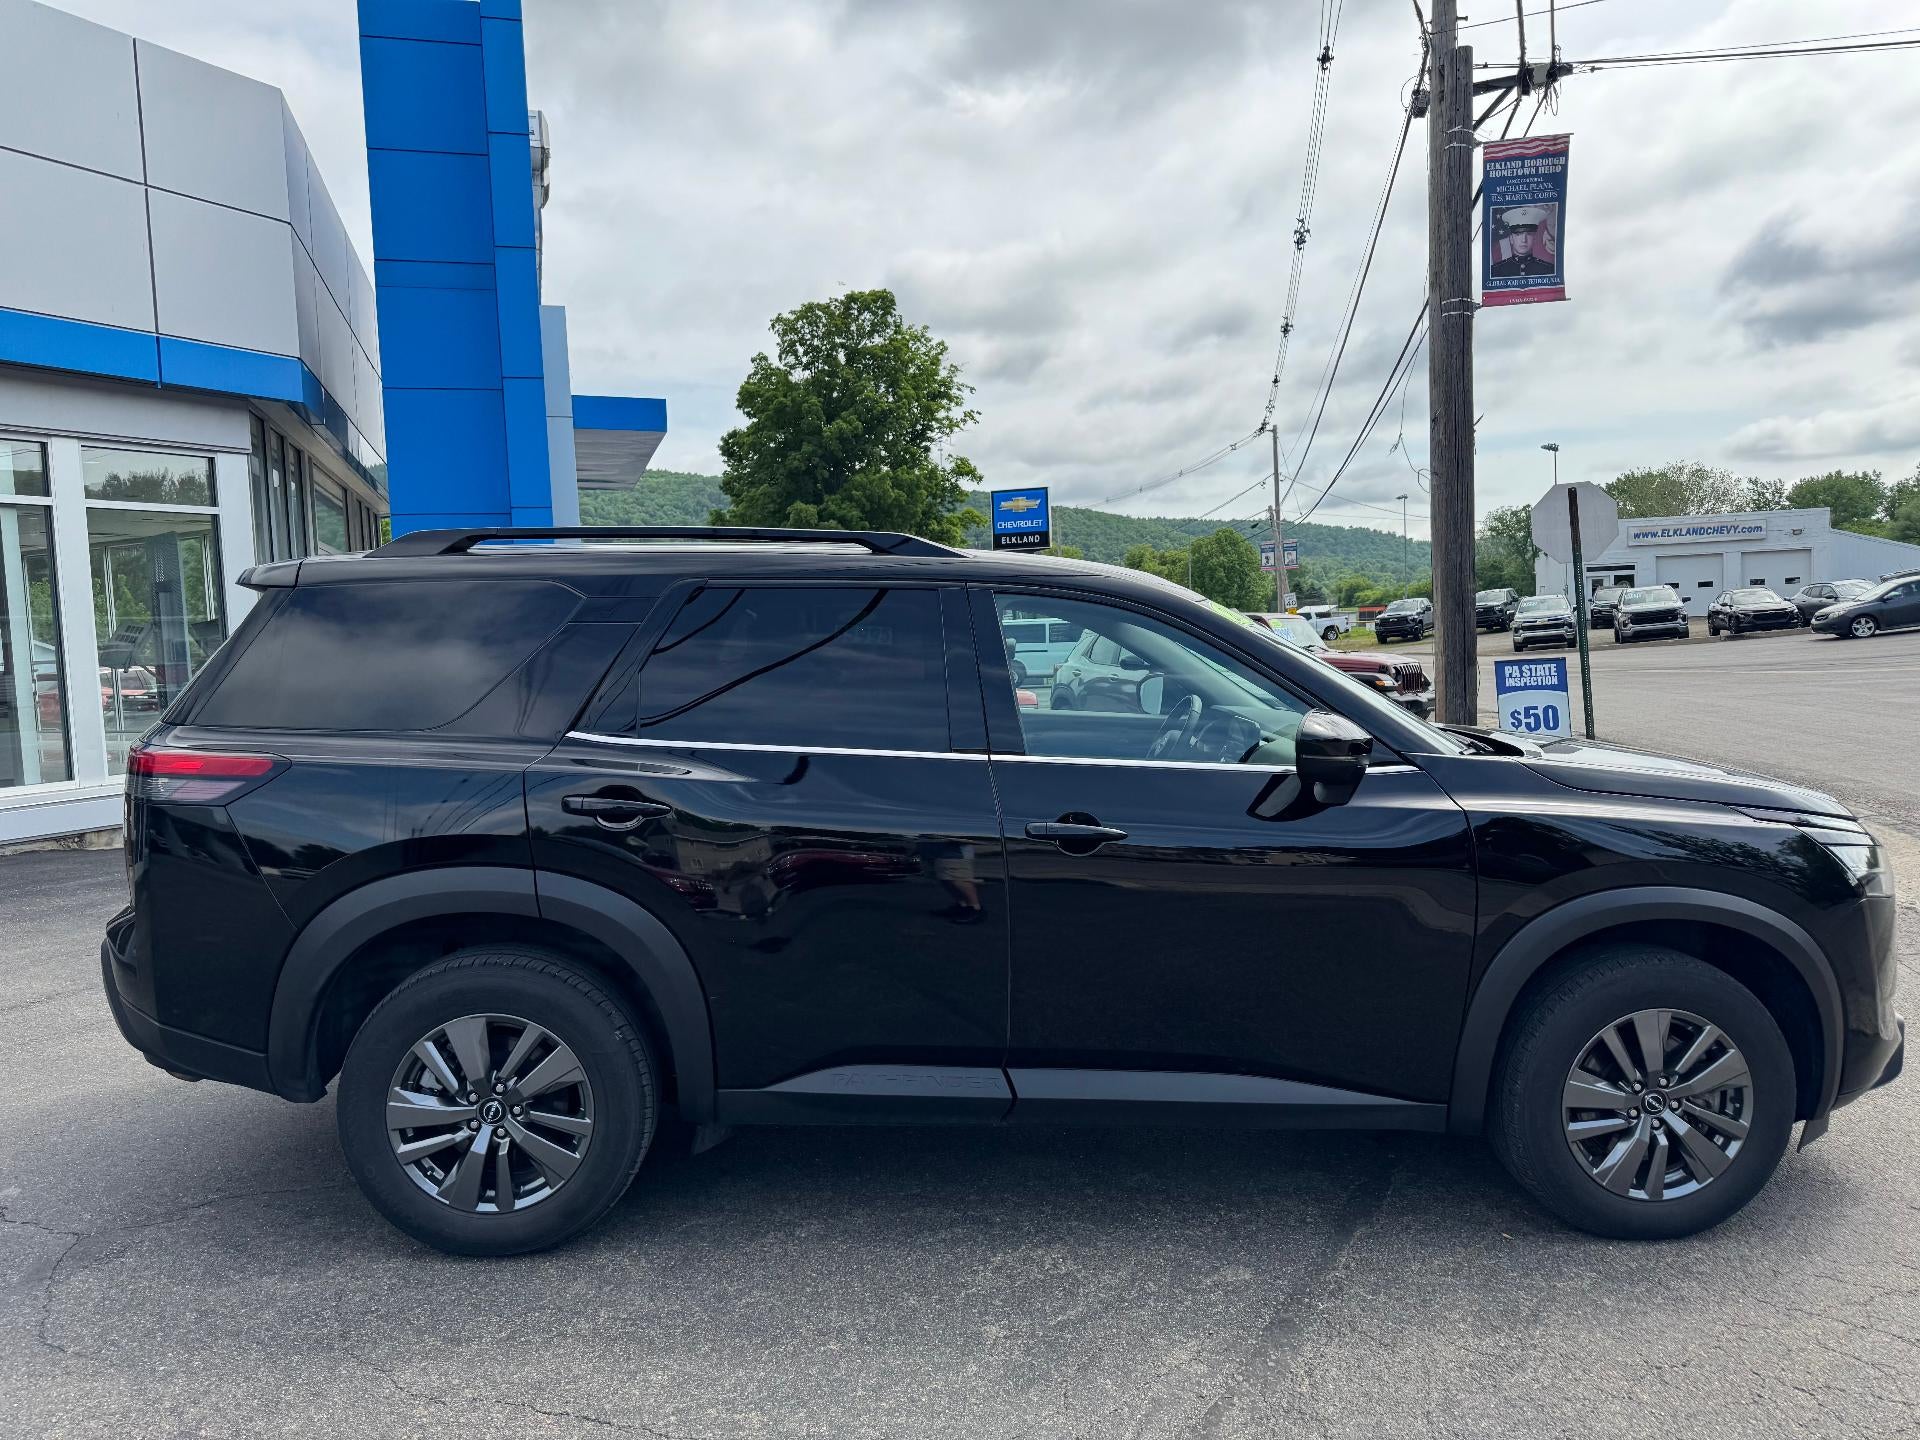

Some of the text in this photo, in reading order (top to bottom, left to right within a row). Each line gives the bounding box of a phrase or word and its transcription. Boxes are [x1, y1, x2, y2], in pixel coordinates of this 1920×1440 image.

[1486, 156, 1566, 171] ELKLAND BOROUGH
[1489, 165, 1562, 178] HOMETOWN HERO
[1496, 182, 1554, 192] MICHAEL PLANK
[1505, 193, 1534, 201] MARINE
[1534, 191, 1558, 199] CORPS
[997, 519, 1043, 529] CHEVROLET
[1633, 524, 1763, 540] www.ELKLANDCHEVY.com
[1001, 534, 1041, 545] ELKLAND
[1504, 663, 1558, 678] PA STATE
[1505, 675, 1558, 687] INSPECTION
[1509, 704, 1560, 733] $50
